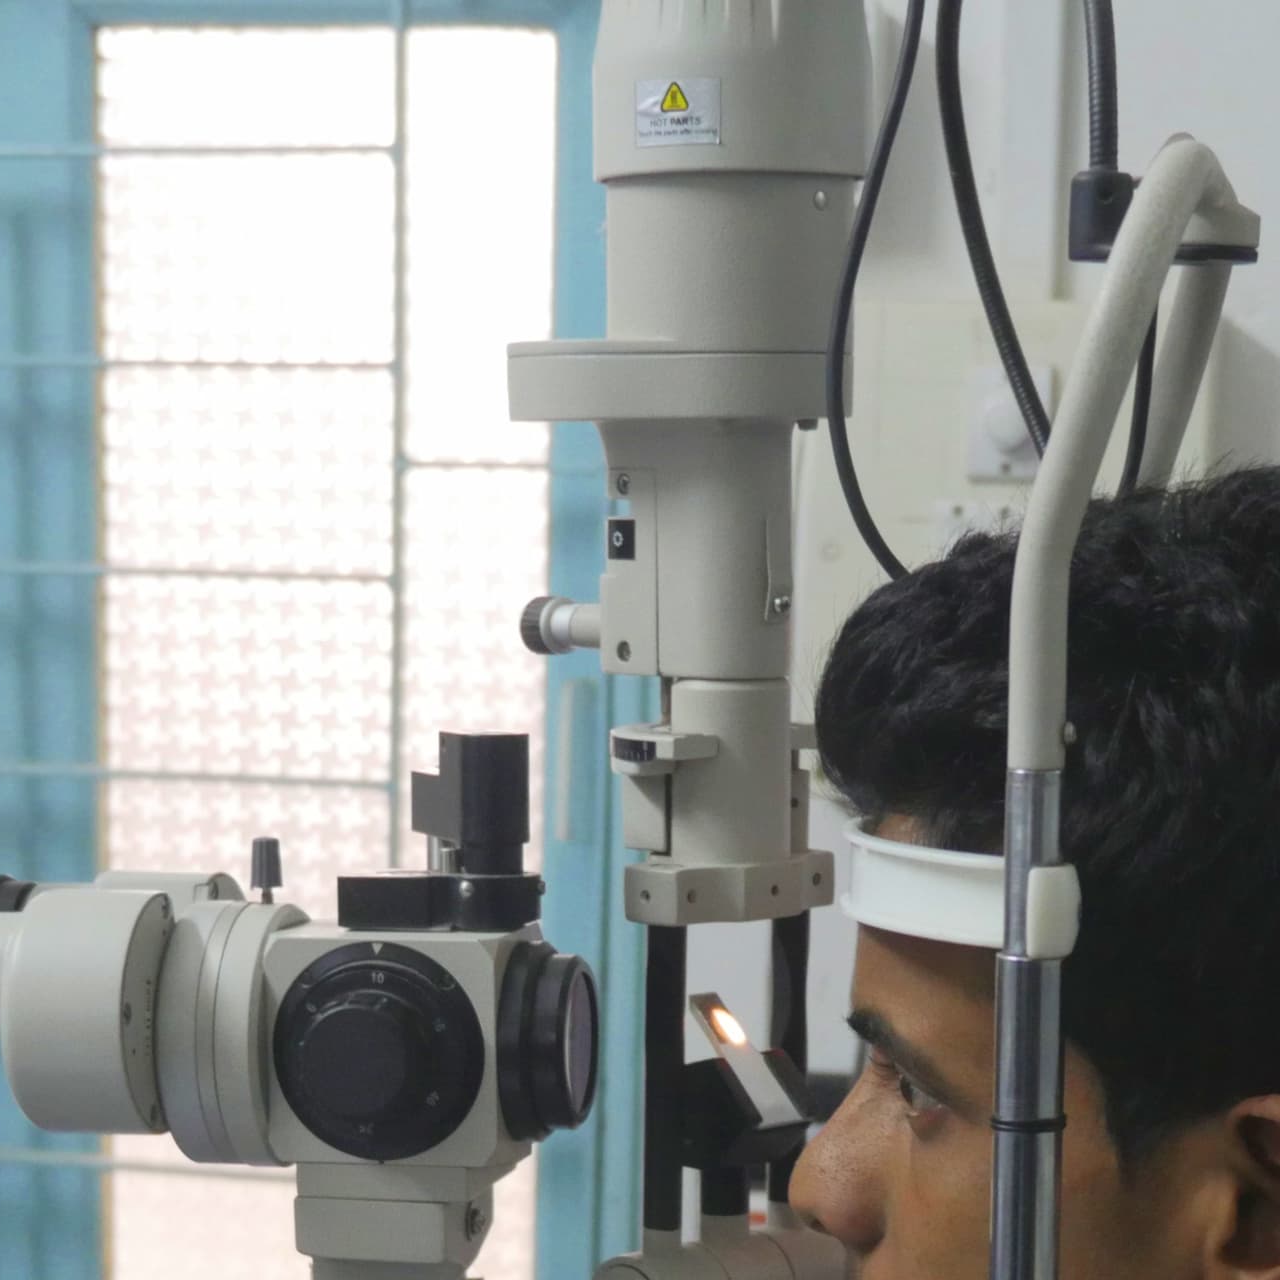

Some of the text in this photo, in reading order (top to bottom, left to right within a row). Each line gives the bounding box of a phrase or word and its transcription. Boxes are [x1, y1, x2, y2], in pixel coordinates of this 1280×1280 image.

[650, 116, 701, 128] HOT PARTS
[371, 972, 385, 985] 10
